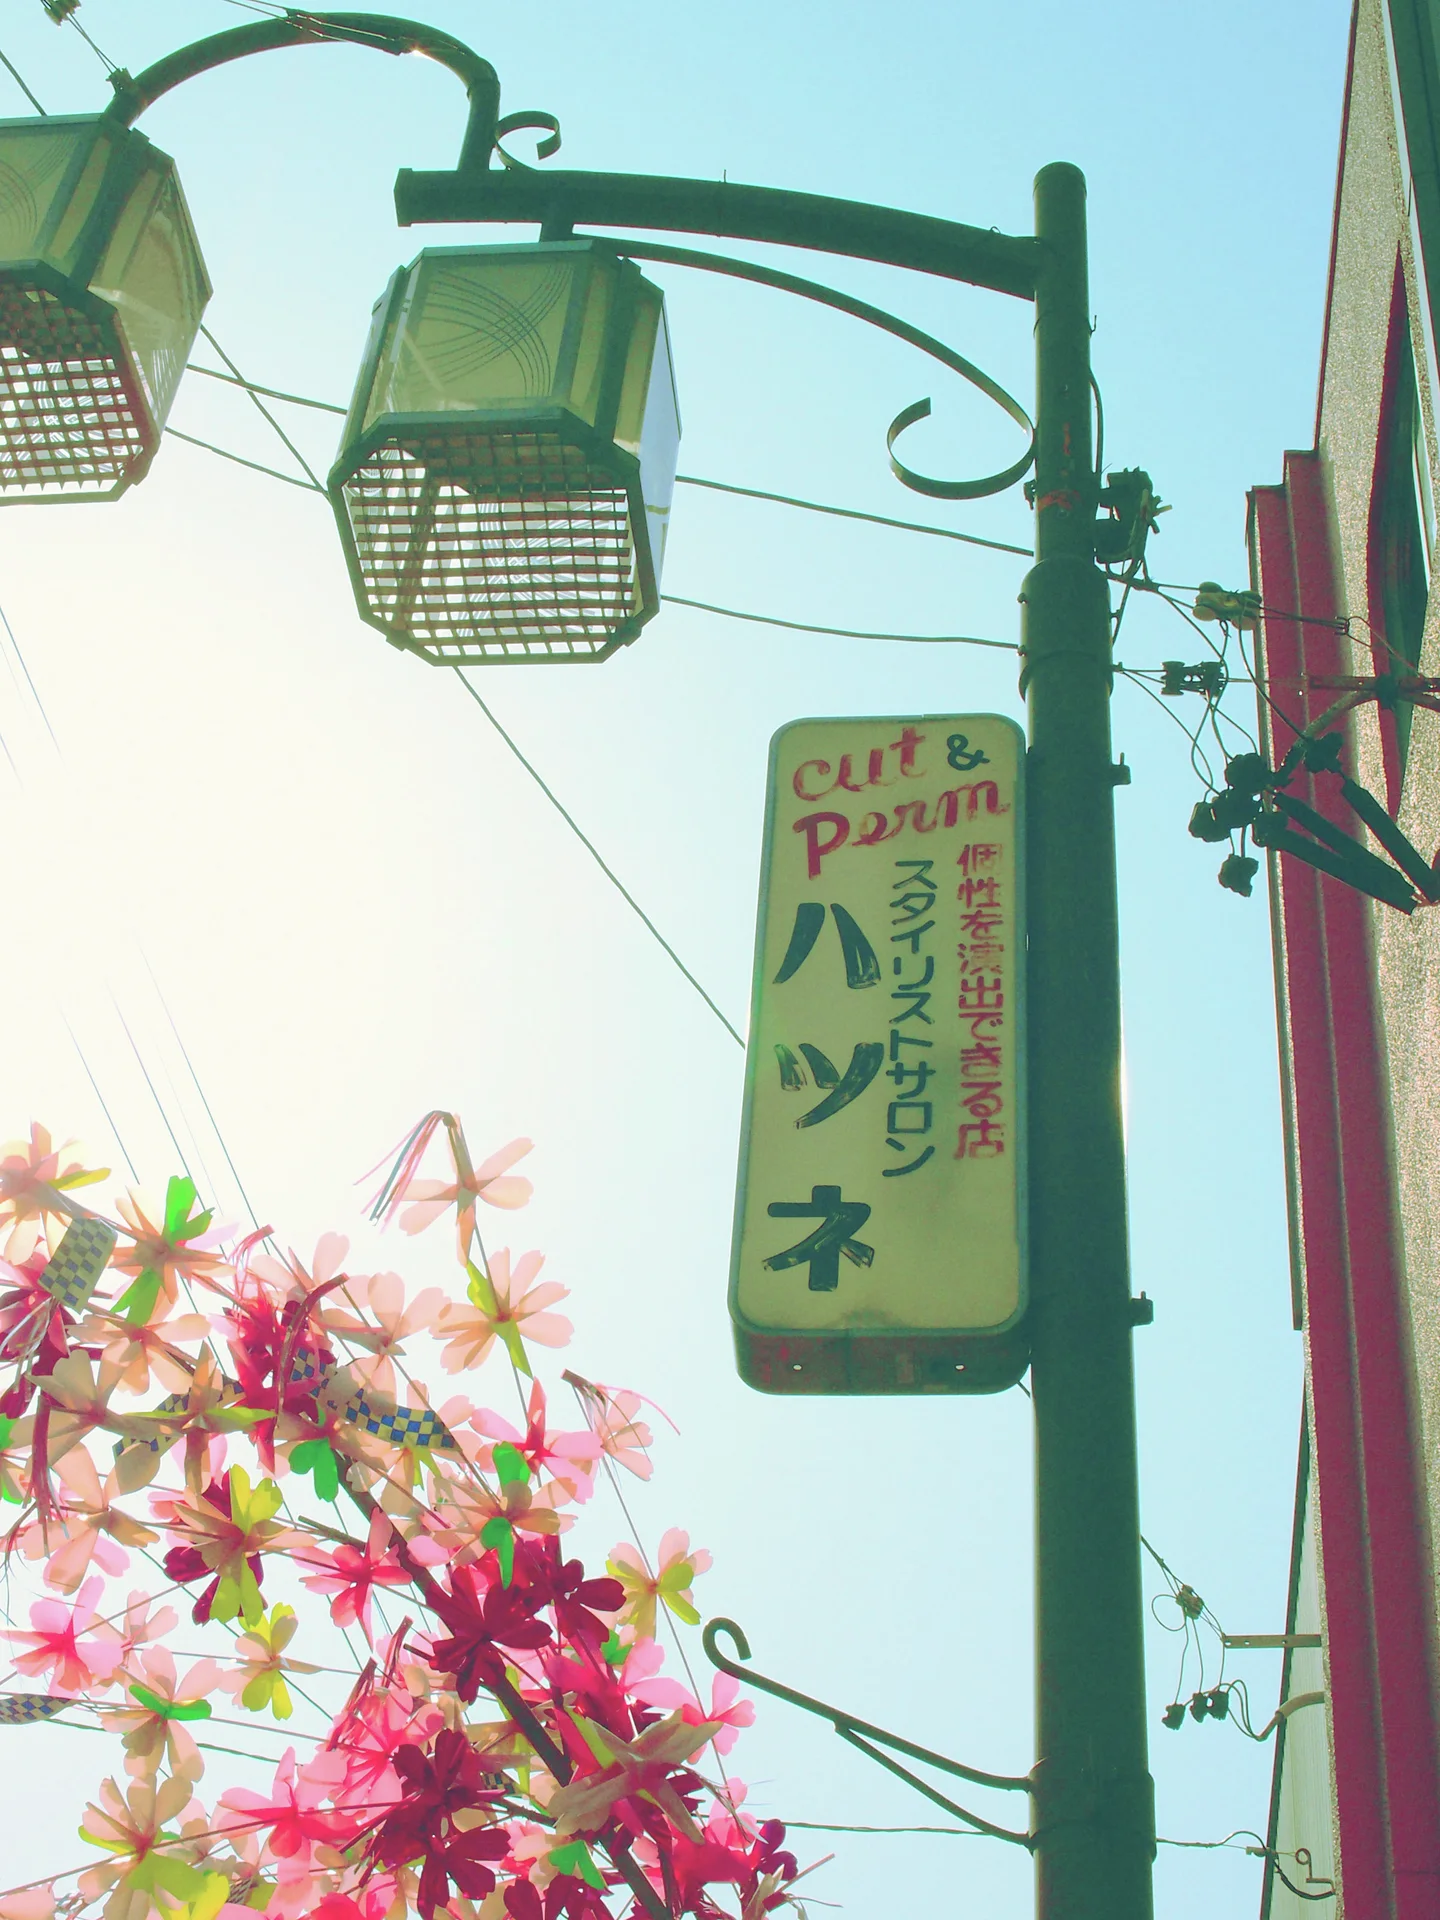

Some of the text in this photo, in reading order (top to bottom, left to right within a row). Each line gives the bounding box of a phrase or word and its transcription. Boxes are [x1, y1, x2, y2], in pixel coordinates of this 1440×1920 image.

[793, 780, 1011, 880] Perm
[947, 734, 990, 771] &
[763, 902, 885, 1292] ハツネ
[881, 860, 938, 1178] スタイリストサロン
[953, 844, 1005, 1160] 個性を演出できる店
